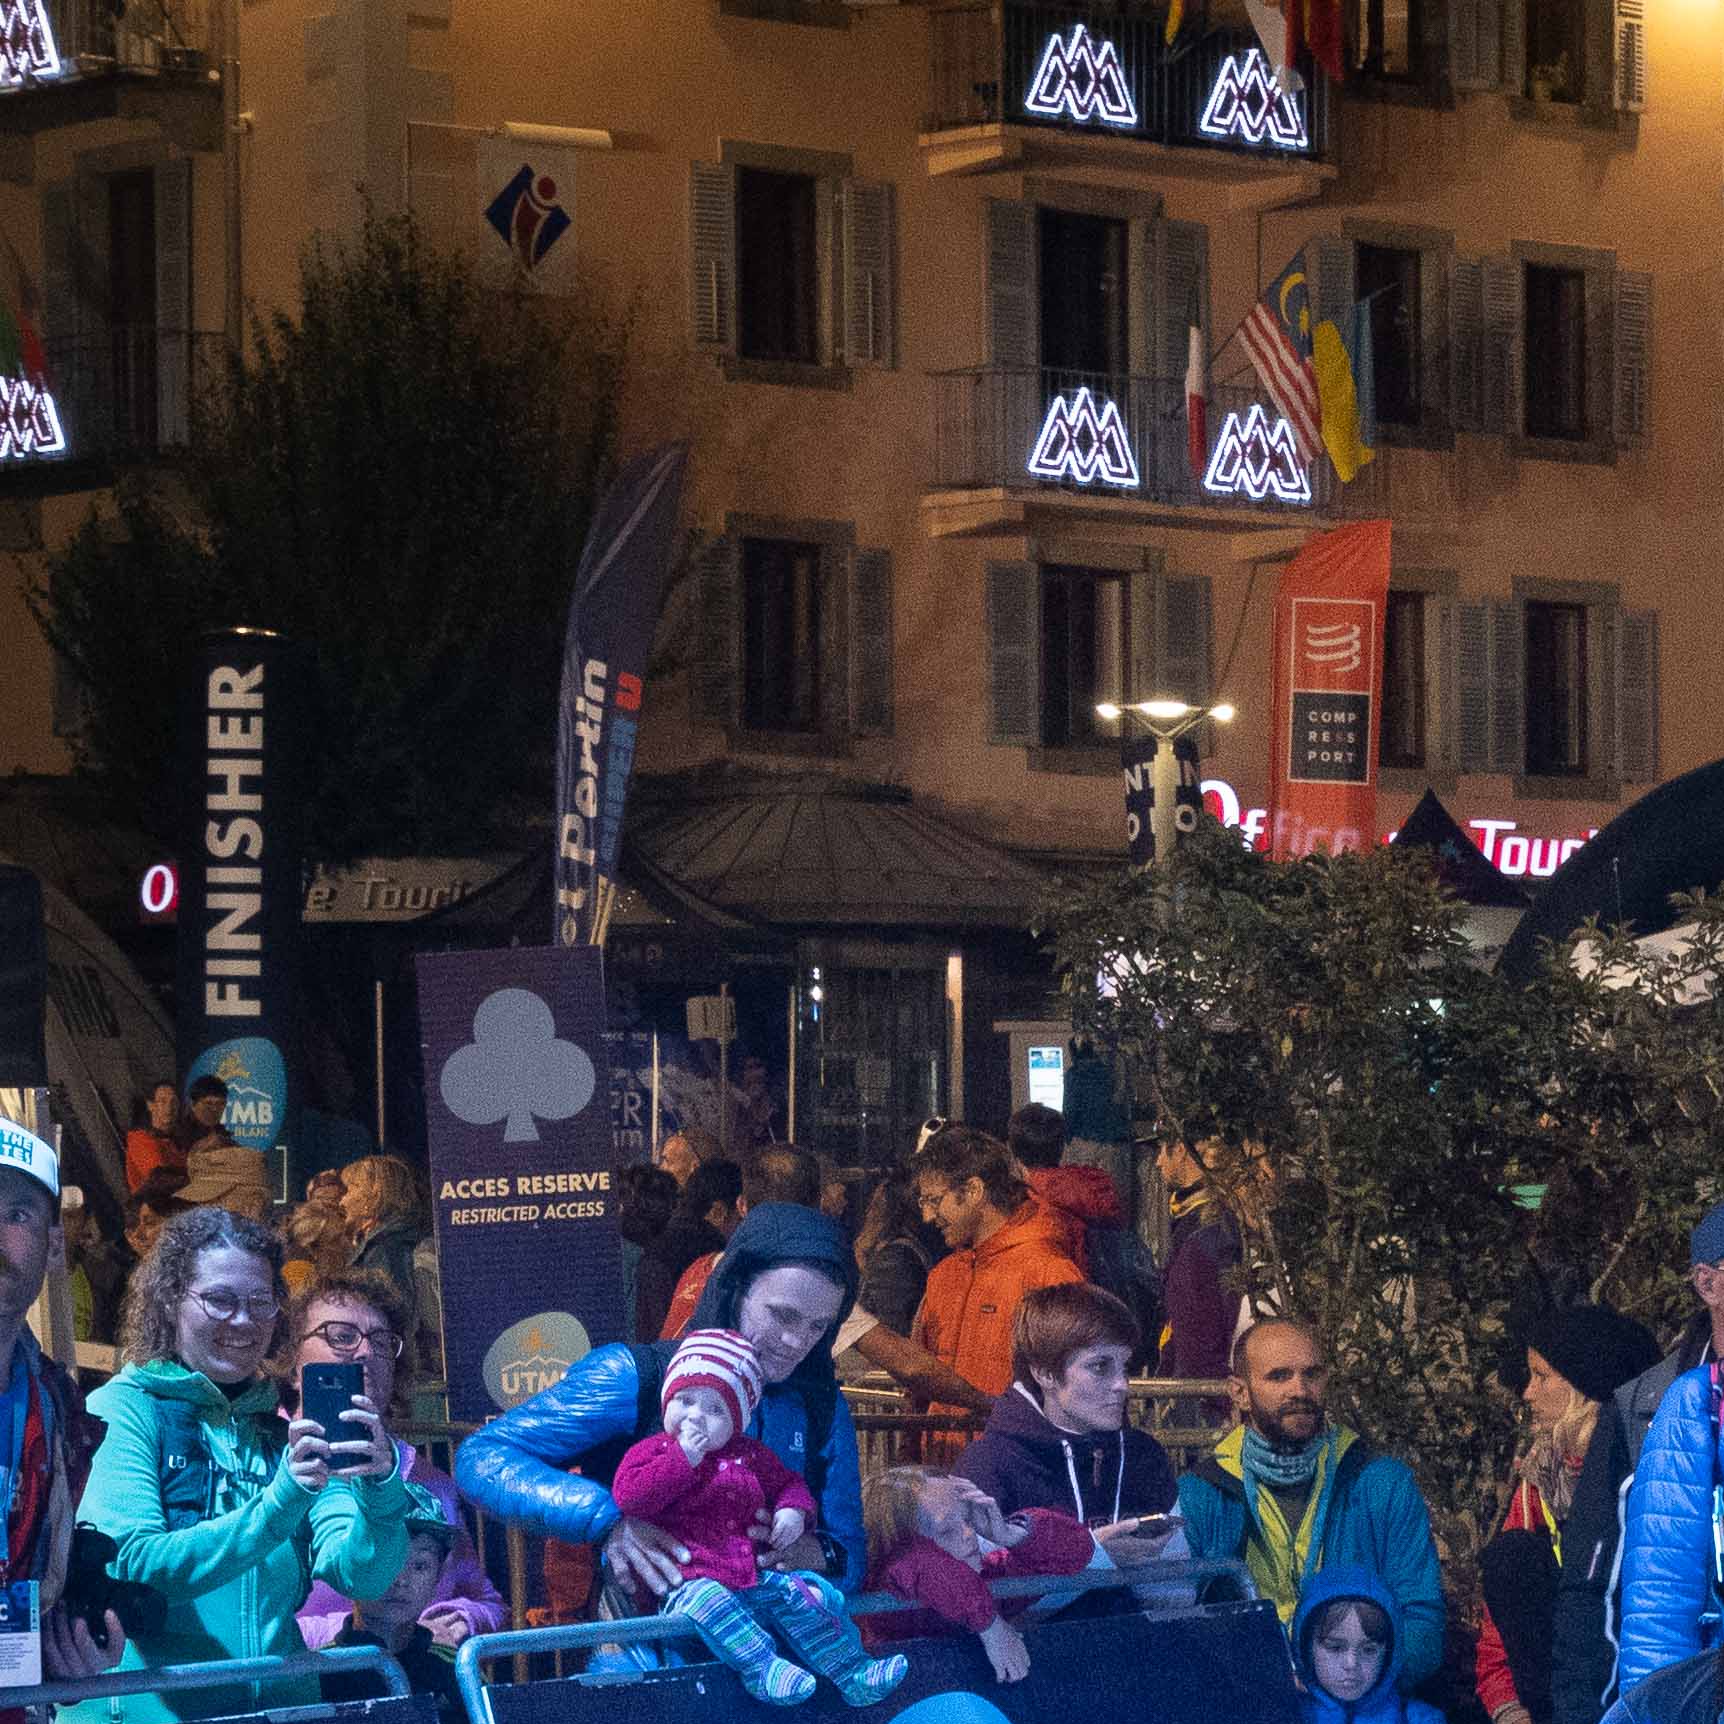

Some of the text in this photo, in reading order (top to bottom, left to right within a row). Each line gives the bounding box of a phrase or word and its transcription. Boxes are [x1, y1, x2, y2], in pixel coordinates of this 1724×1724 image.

[1308, 710, 1358, 724] COMP
[1308, 731, 1357, 744] RESS
[1308, 750, 1356, 764] PORT
[205, 663, 264, 1017] FINISHER
[440, 1171, 611, 1200] ACCES RESERVE
[451, 1201, 606, 1226] RESTRICTED ACCESS
[500, 1365, 568, 1394] UTM
